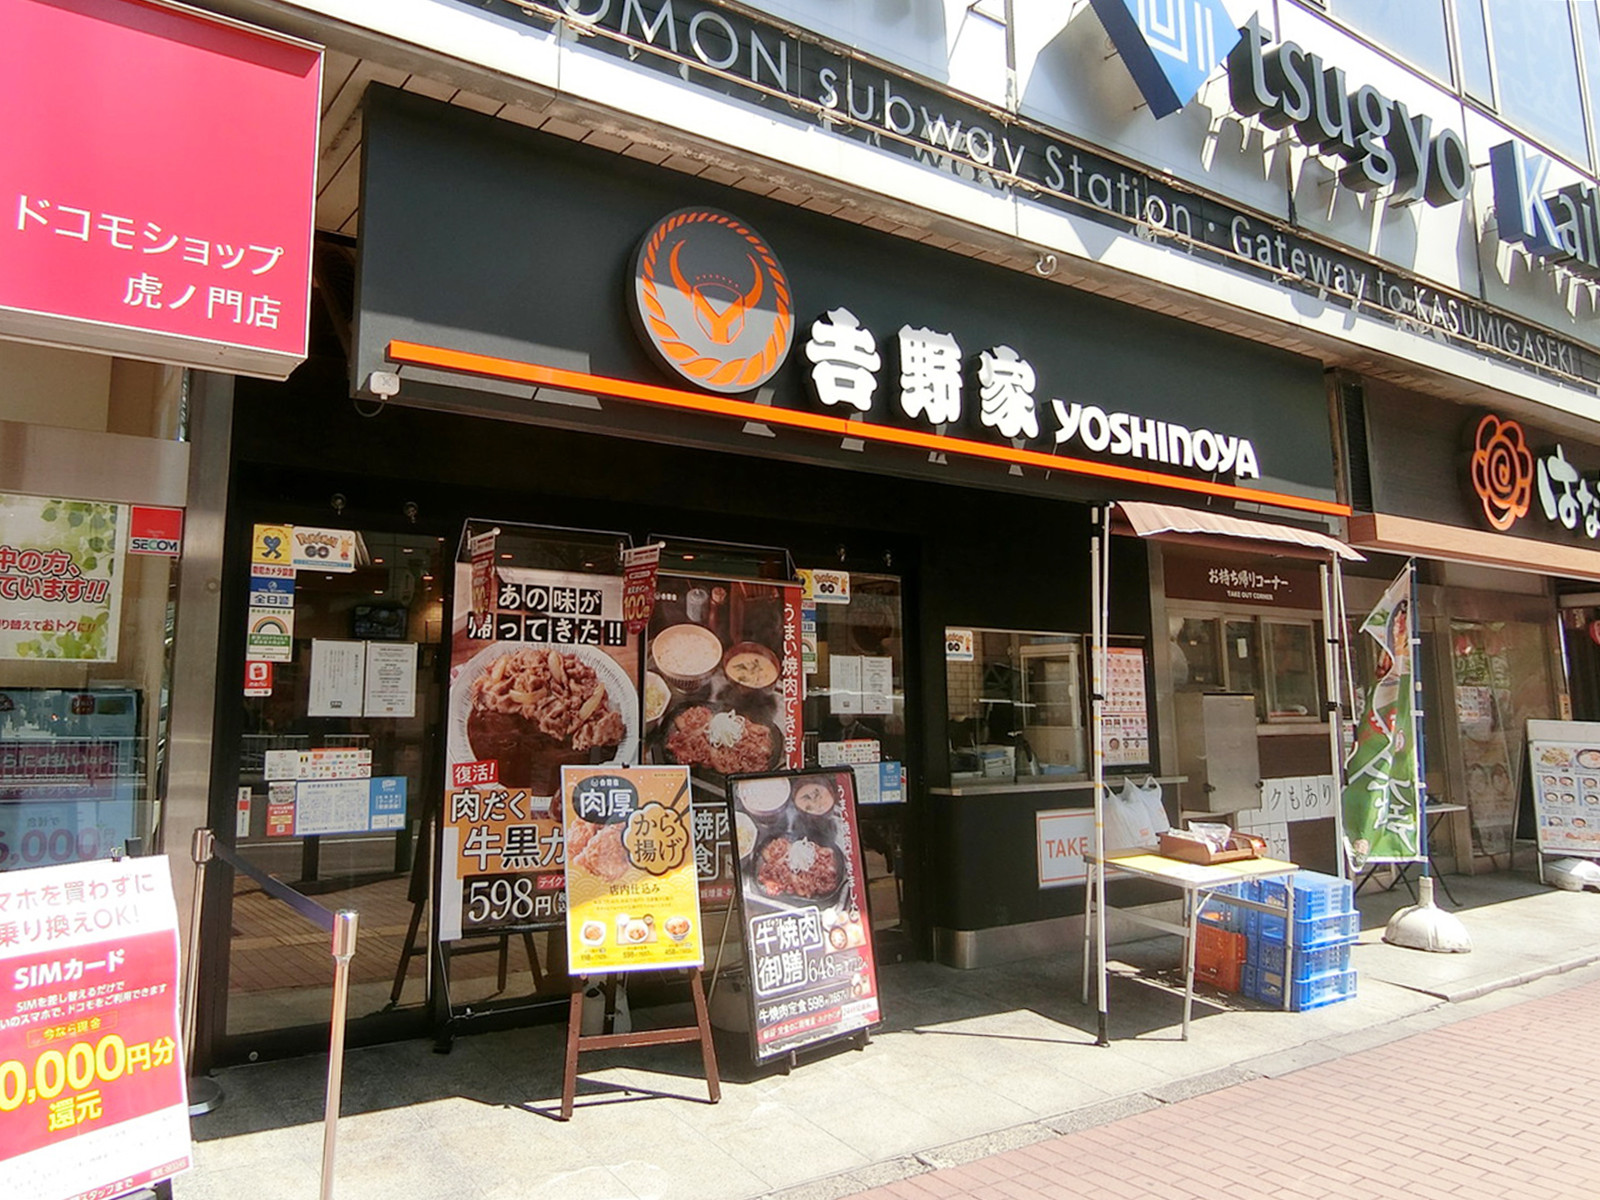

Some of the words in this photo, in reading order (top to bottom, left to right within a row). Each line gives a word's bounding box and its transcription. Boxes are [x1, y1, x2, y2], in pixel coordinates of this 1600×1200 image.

[17, 194, 284, 275] ドコモショップ
[818, 67, 1025, 180] subway
[1045, 144, 1193, 240] Station
[1231, 215, 1366, 308] Gateway
[1377, 272, 1403, 312] to
[1413, 285, 1574, 376] KASUMIGASEKI
[123, 272, 282, 329] 虎ノ門店
[805, 306, 1040, 438] 吉野家
[1052, 398, 1261, 479] YOSHINOYA
[132, 539, 178, 551] SECOM
[304, 545, 330, 559] GO
[1208, 568, 1289, 590] お持ち帰りコーナー
[499, 584, 602, 614] あの味が
[468, 616, 622, 645] 帰ってきた!!
[455, 763, 495, 783] 復活!
[451, 790, 526, 822] 肉だく
[580, 789, 634, 818] 肉厚
[1260, 784, 1331, 811] クもあり
[634, 814, 677, 837] から
[634, 838, 682, 862] 揚げ
[1046, 837, 1088, 858] TAKE
[468, 878, 552, 922] 598円
[610, 883, 660, 895] 店内仕込み
[0, 904, 140, 947] 乗り換えOK!
[756, 913, 817, 954] 牛焼肉
[14, 949, 125, 990] SIMカード
[757, 949, 804, 990] 御膳
[16, 981, 125, 1013] SIMを差し替えるだけで
[48, 1090, 103, 1132] 還元
